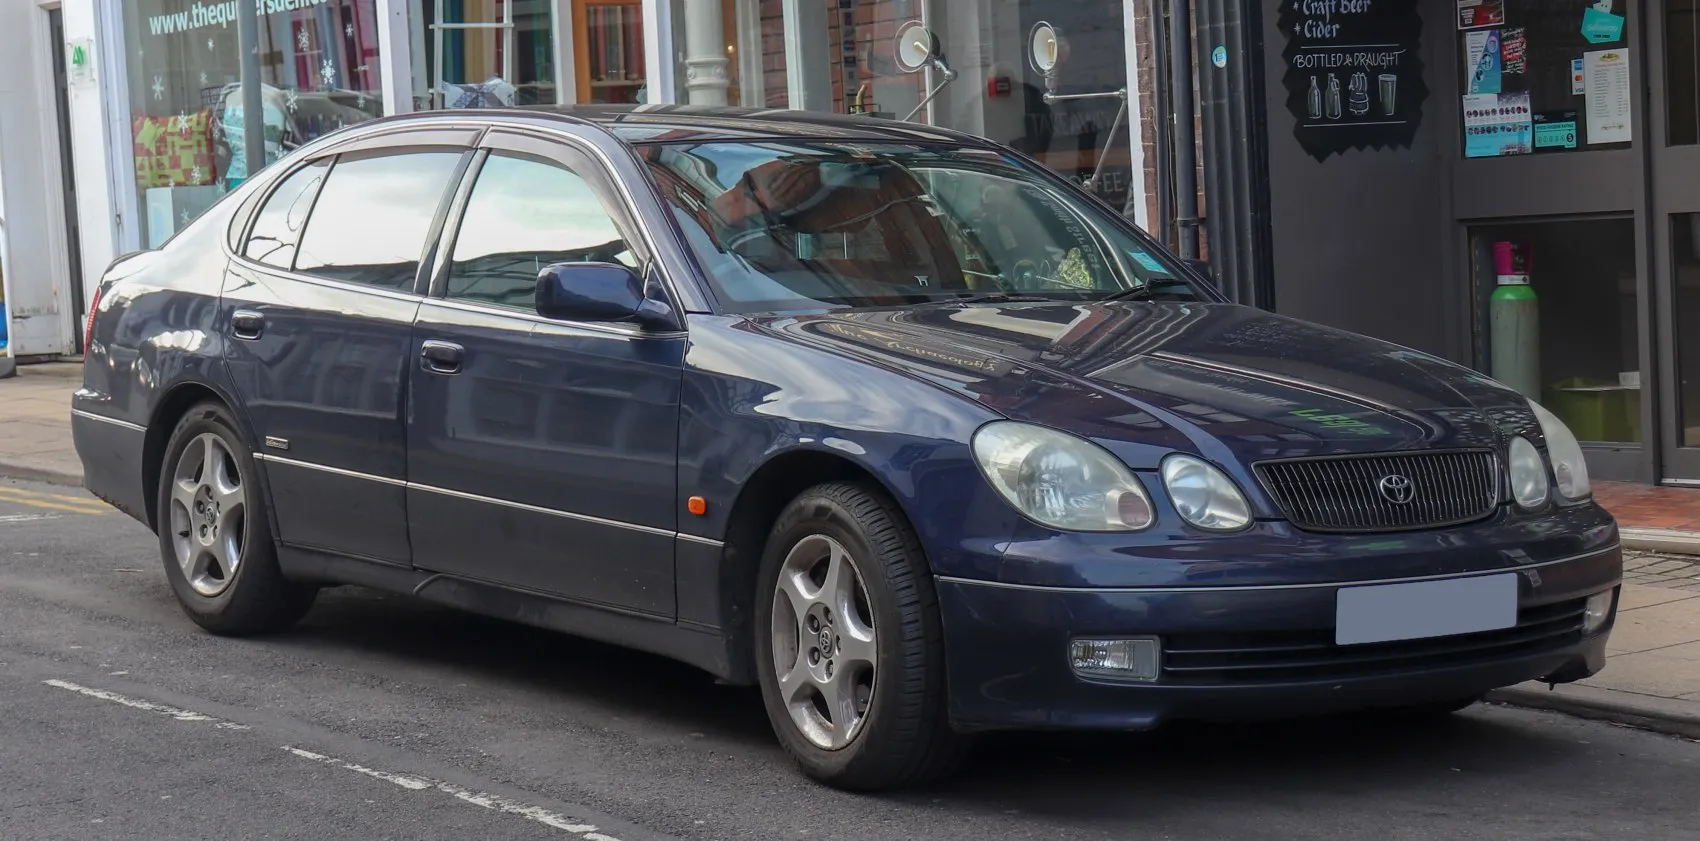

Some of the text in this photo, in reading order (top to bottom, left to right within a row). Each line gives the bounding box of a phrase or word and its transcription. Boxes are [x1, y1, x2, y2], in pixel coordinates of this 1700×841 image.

[1303, 0, 1337, 22] Craft
[1304, 20, 1340, 38] Cider
[1293, 53, 1343, 68] BOTTLED
[1354, 49, 1406, 71] DRAUGHT
